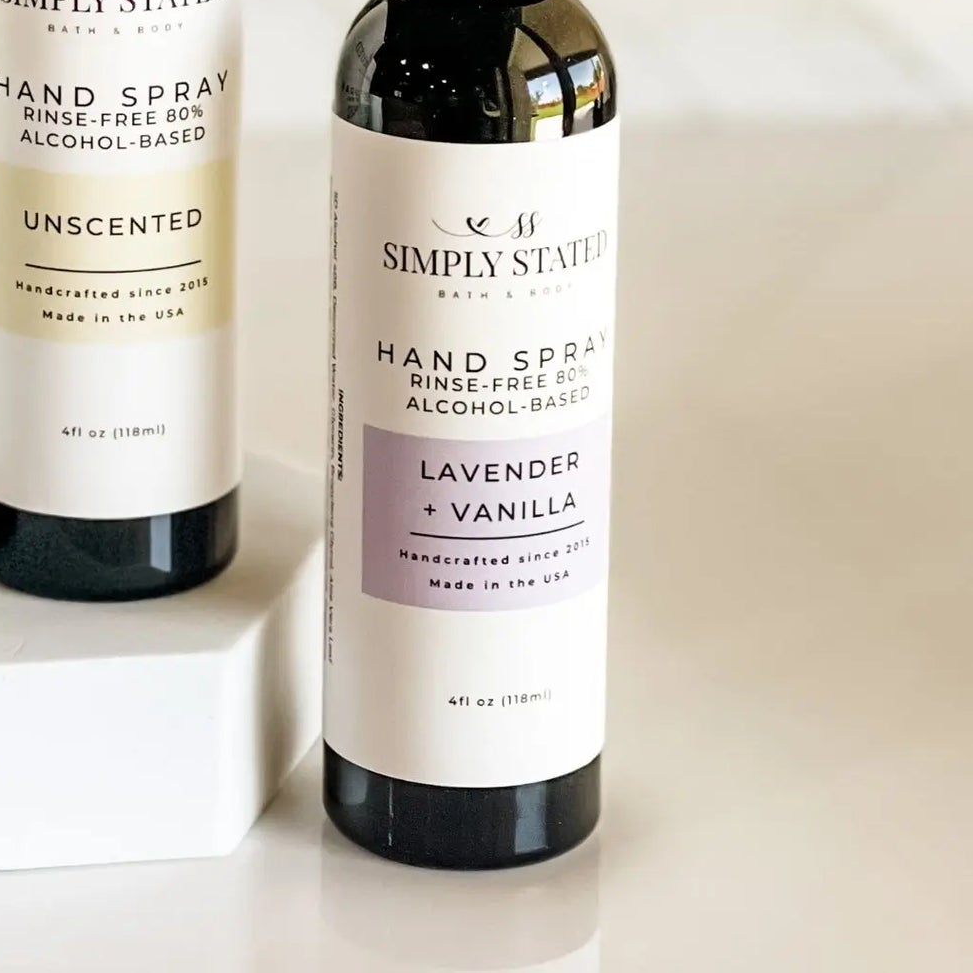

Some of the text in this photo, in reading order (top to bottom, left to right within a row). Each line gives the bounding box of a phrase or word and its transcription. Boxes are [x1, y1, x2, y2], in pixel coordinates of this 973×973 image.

[48, 22, 183, 35] BATH & BODY
[122, 69, 228, 107] SPRAY
[23, 104, 203, 127] RINSE-FREE 80%
[20, 126, 206, 150] ALCOHOL-BASED
[24, 208, 202, 236] UNSCENTED
[382, 229, 608, 277] SIMPLY STATED
[15, 276, 209, 299] Handcrafted since 2015
[438, 289, 489, 300] BATH
[42, 307, 185, 323] Made in the USA
[377, 326, 608, 373] HAND SPRAY
[410, 365, 588, 393] RINSE-FREE 80%
[406, 386, 590, 416] ALCOHOL-BASED
[61, 424, 166, 440] 4fl oz (118ml)
[420, 451, 580, 483] LAVENDER
[423, 491, 577, 522] + VANILLA
[399, 537, 591, 566] Handcrafted since 2015
[429, 569, 570, 590] Made in the USA
[448, 689, 552, 708] 4fl oz (118ml)
